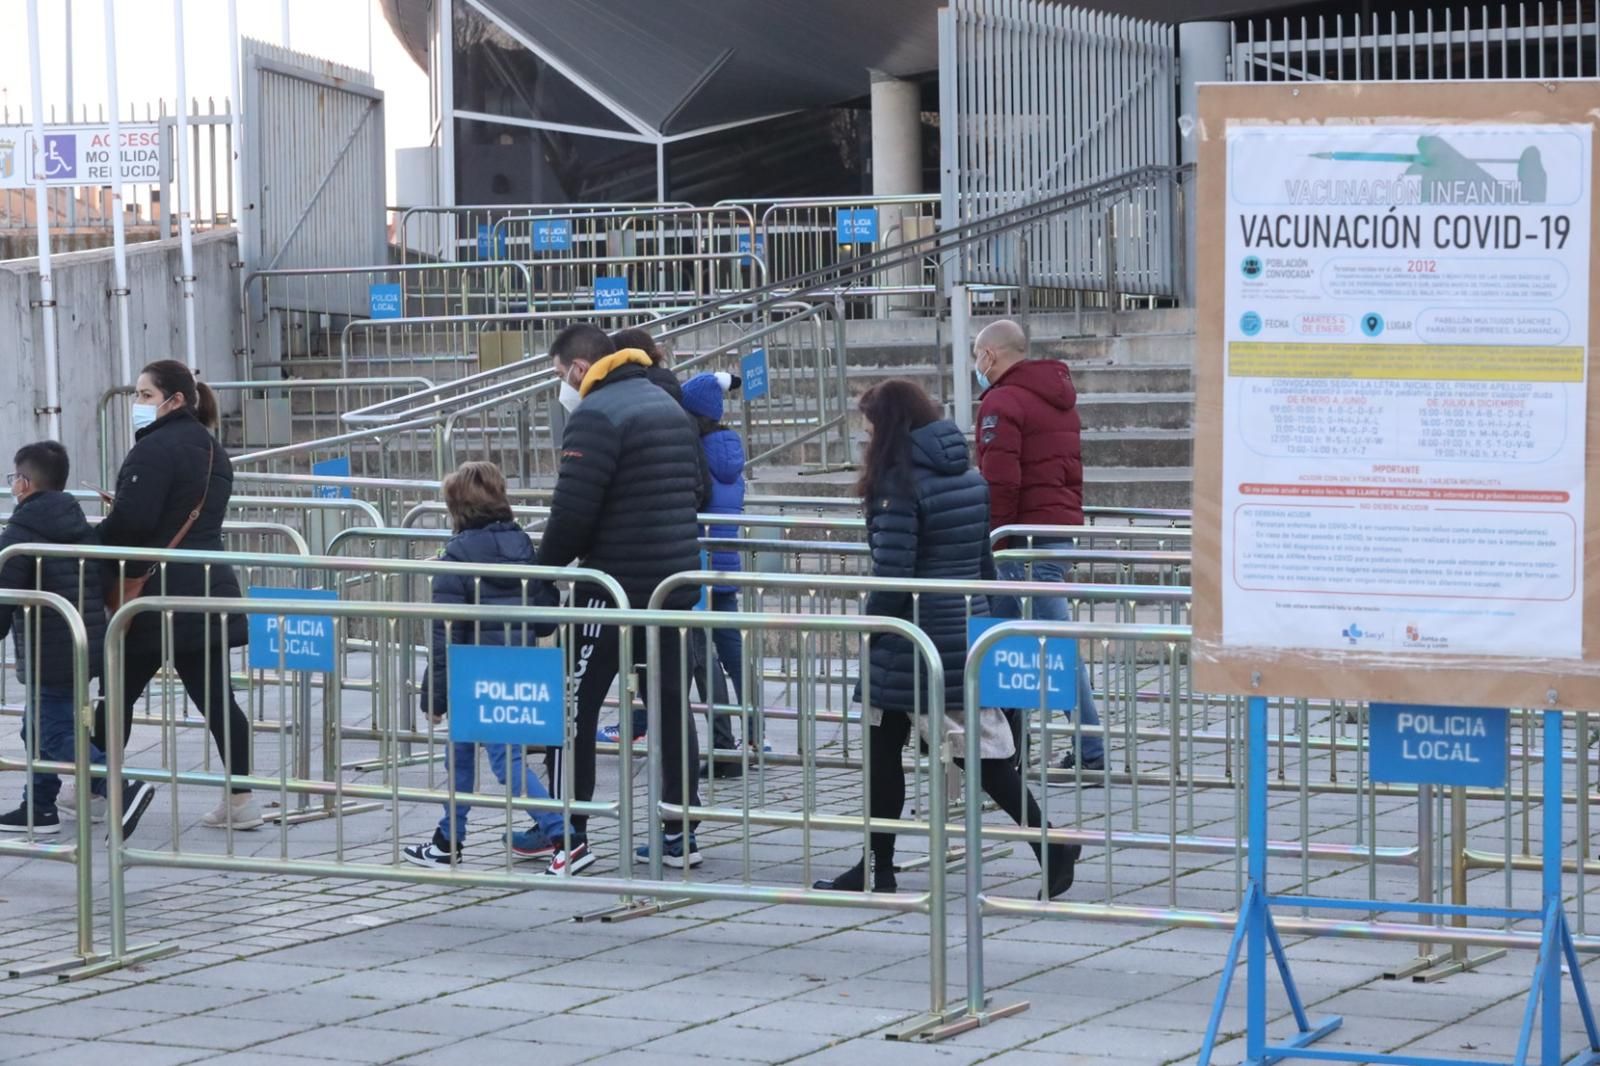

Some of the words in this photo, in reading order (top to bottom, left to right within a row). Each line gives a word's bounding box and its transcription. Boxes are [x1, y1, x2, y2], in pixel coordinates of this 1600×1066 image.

[86, 149, 159, 162] MOILIDA
[88, 165, 160, 178] REUCID
[1284, 173, 1422, 205] VACUNACIÓN
[1431, 180, 1530, 205] INFANTIL
[1240, 206, 1421, 249] VACUNACIÓN
[1433, 214, 1571, 250] COVID-19
[1265, 258, 1308, 268] POBLACIÓN
[1407, 260, 1436, 272] 2012
[596, 288, 625, 297] POLICIA
[598, 298, 623, 307] LOCAL
[1265, 319, 1289, 328] FECHA
[1302, 316, 1336, 324] MARTES
[1386, 321, 1412, 331] LUGAR
[1302, 325, 1313, 333] DE
[1316, 325, 1345, 333] ENERO
[1372, 464, 1419, 474] IMPORTANTE
[267, 618, 324, 637] PLICIA
[474, 680, 550, 702] POLICIA
[479, 705, 546, 725] LOCAL
[1397, 713, 1486, 737] POLICIA
[1402, 739, 1480, 763] LOCAL
